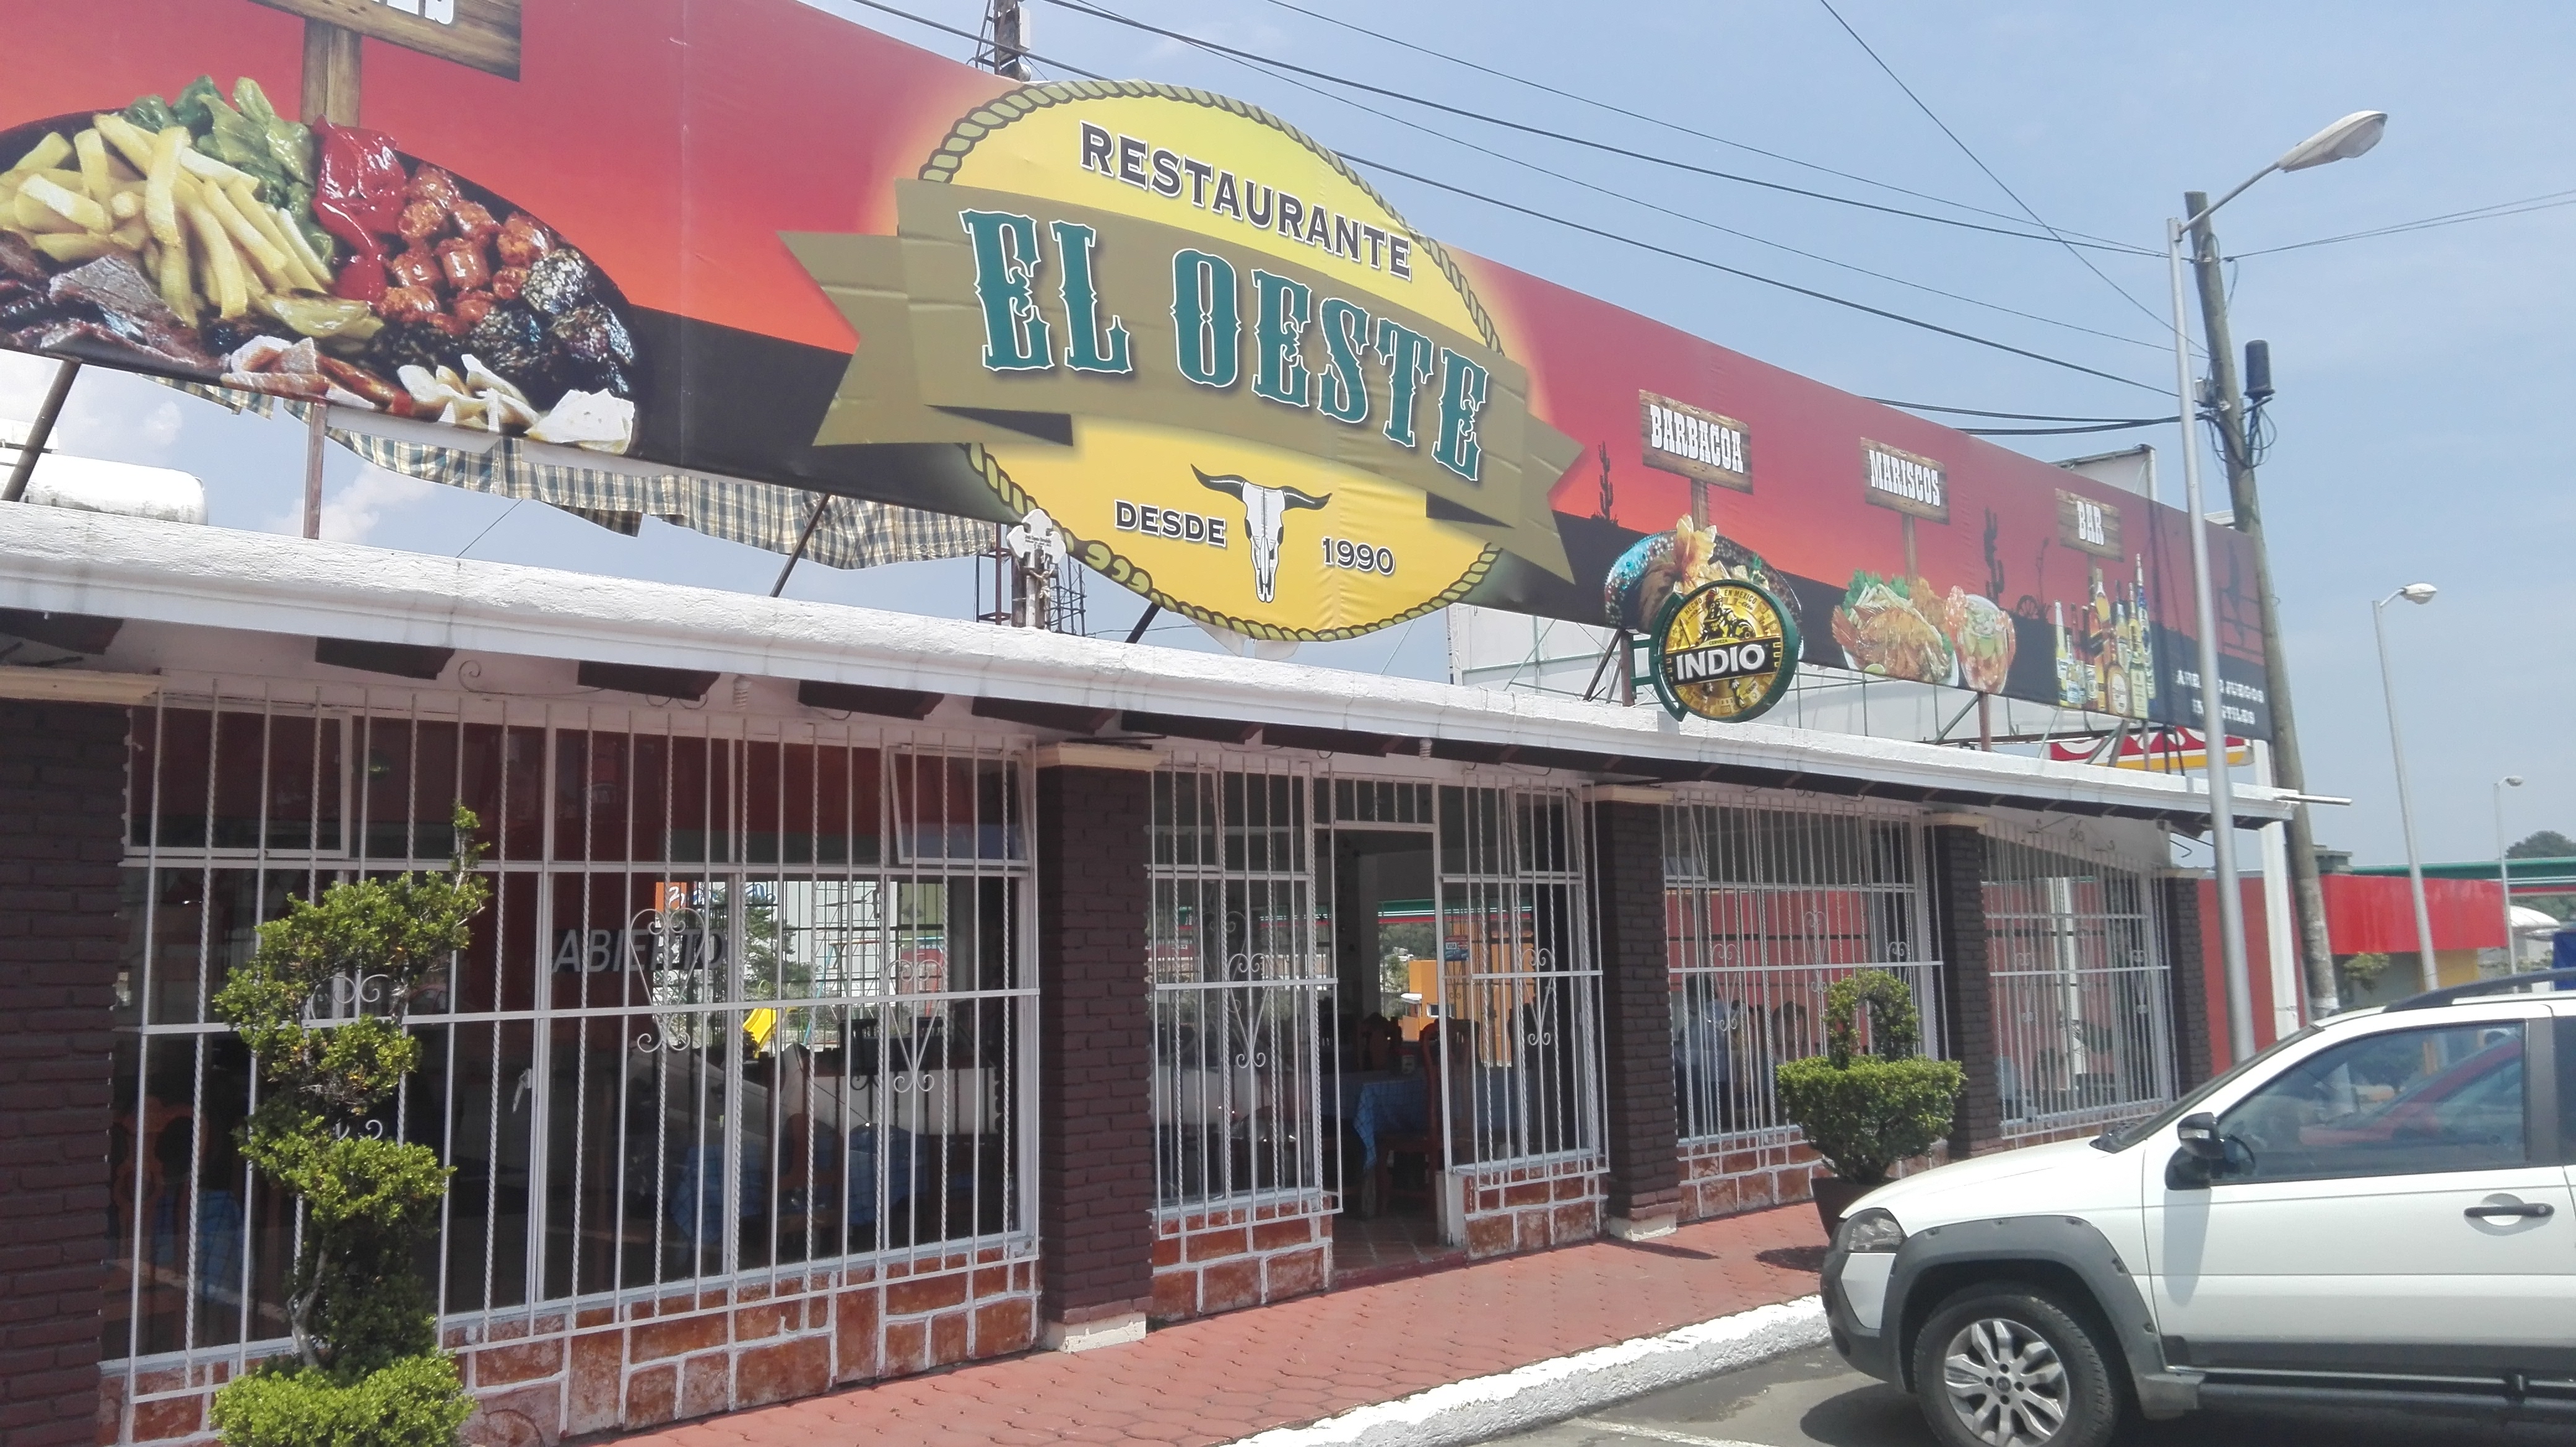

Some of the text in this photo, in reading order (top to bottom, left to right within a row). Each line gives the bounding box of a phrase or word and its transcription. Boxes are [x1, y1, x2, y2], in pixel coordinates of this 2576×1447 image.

[1080, 121, 1412, 281] RESTAURANTE
[959, 209, 1489, 481] EL OESTE
[1650, 404, 1743, 473] BARBACOA
[1869, 450, 1941, 506] MARISCOS
[1114, 499, 1395, 575] DESDE 1990
[2077, 501, 2104, 546] BAR
[1676, 644, 1765, 680] INDIO
[552, 929, 726, 973] ABIERTO
